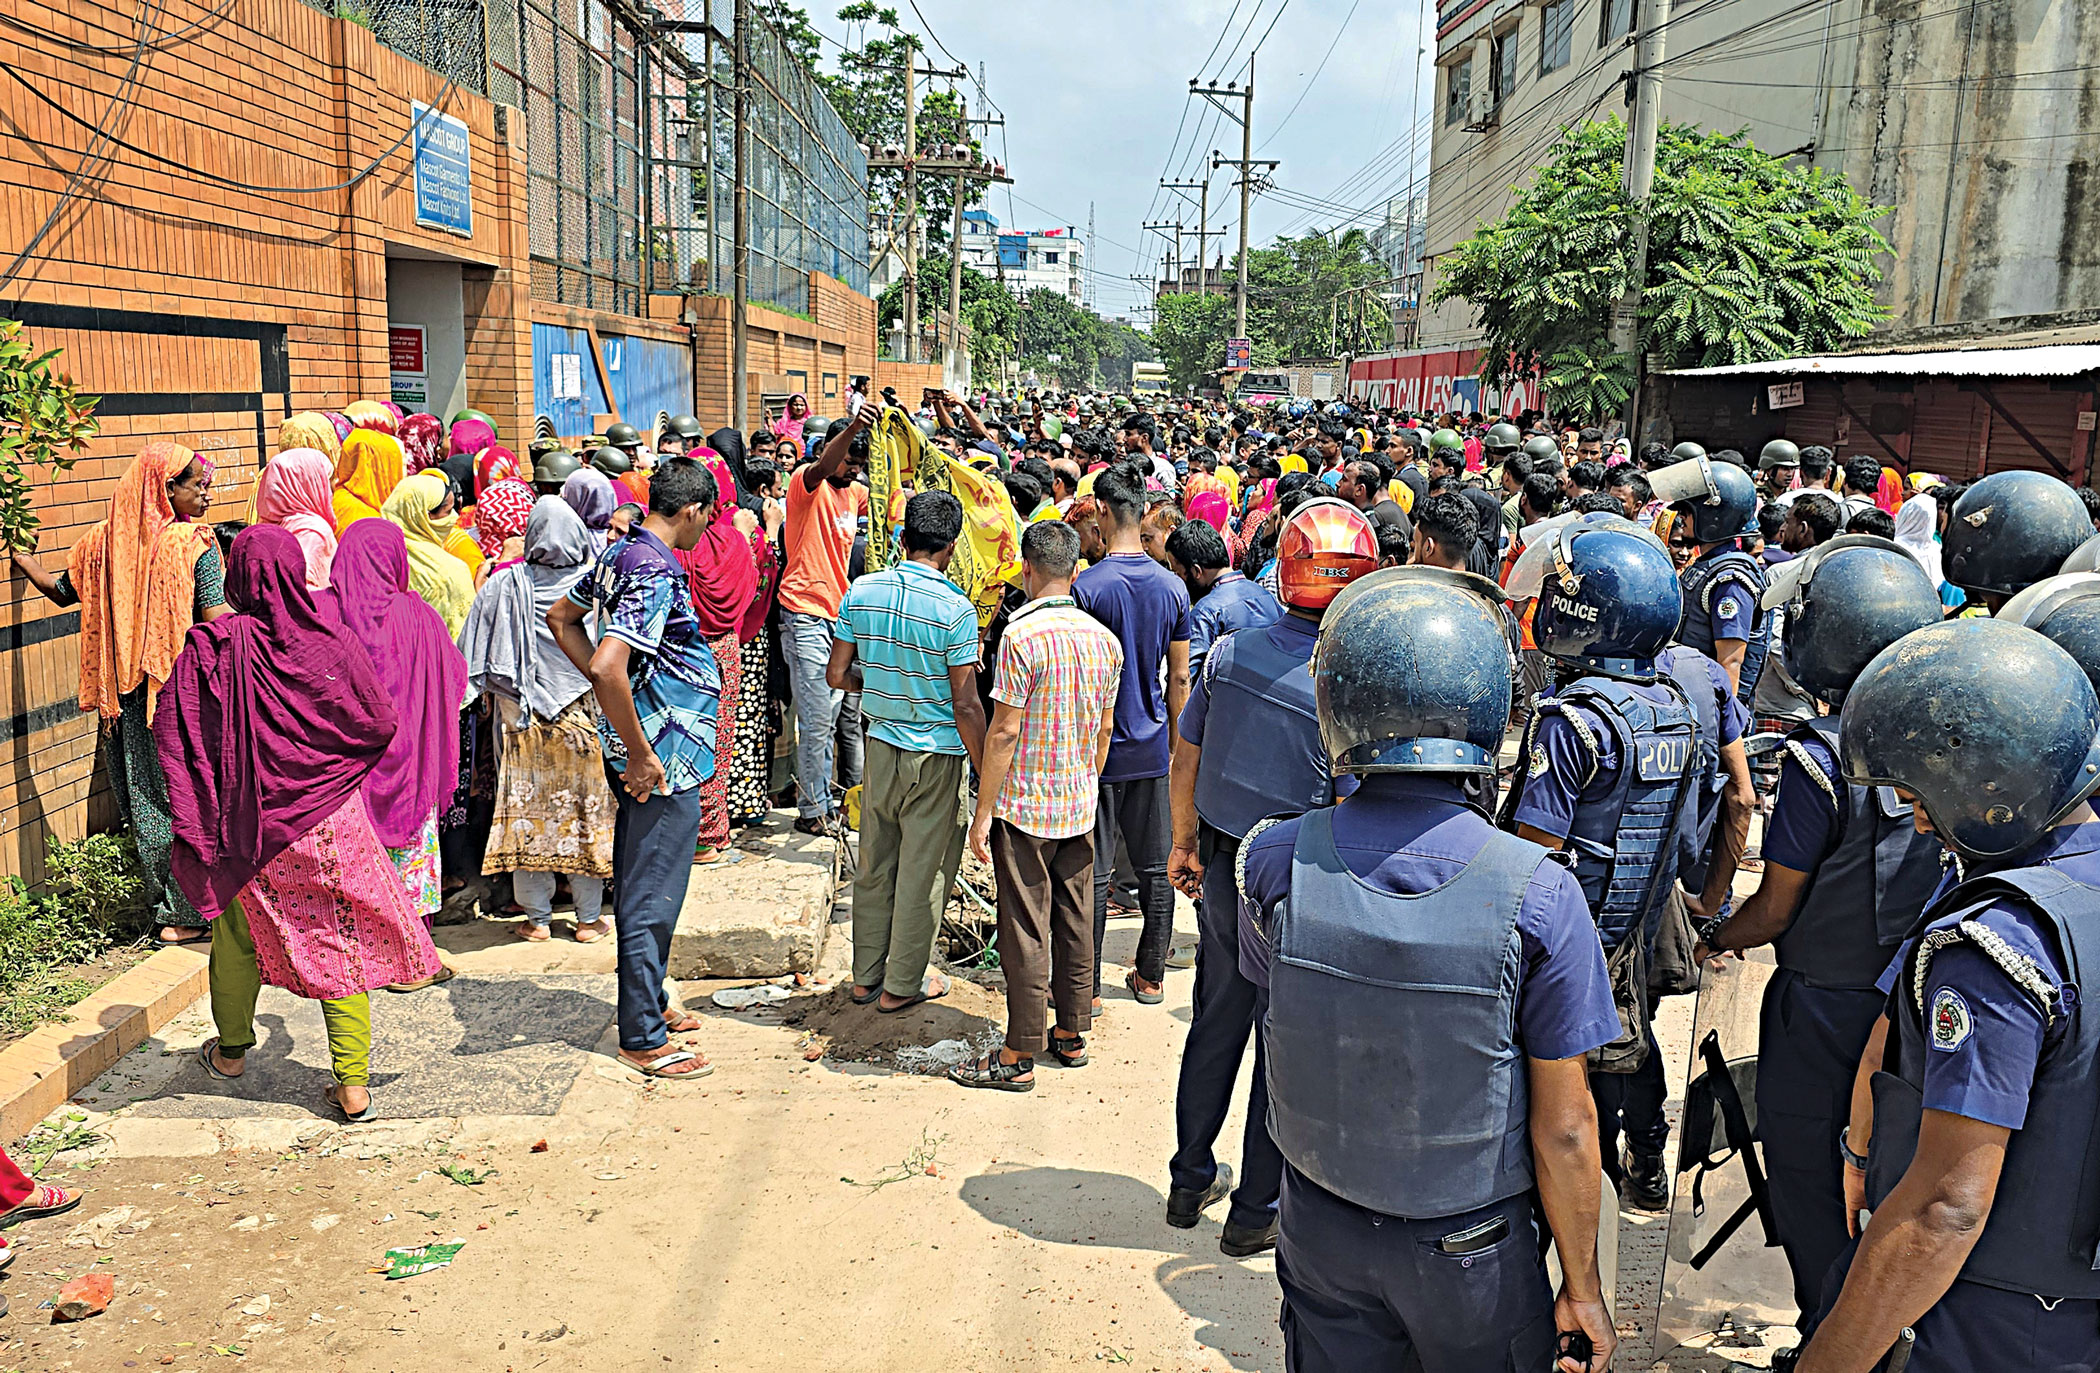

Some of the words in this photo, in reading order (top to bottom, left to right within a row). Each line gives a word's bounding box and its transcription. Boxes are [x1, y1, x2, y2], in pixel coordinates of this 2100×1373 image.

[420, 121, 445, 148] MASCOT
[446, 132, 467, 155] GROUP
[420, 157, 439, 177] Mascot
[421, 175, 439, 195] Mascot
[421, 193, 439, 213] Mascot
[1551, 594, 1599, 623] POLICE
